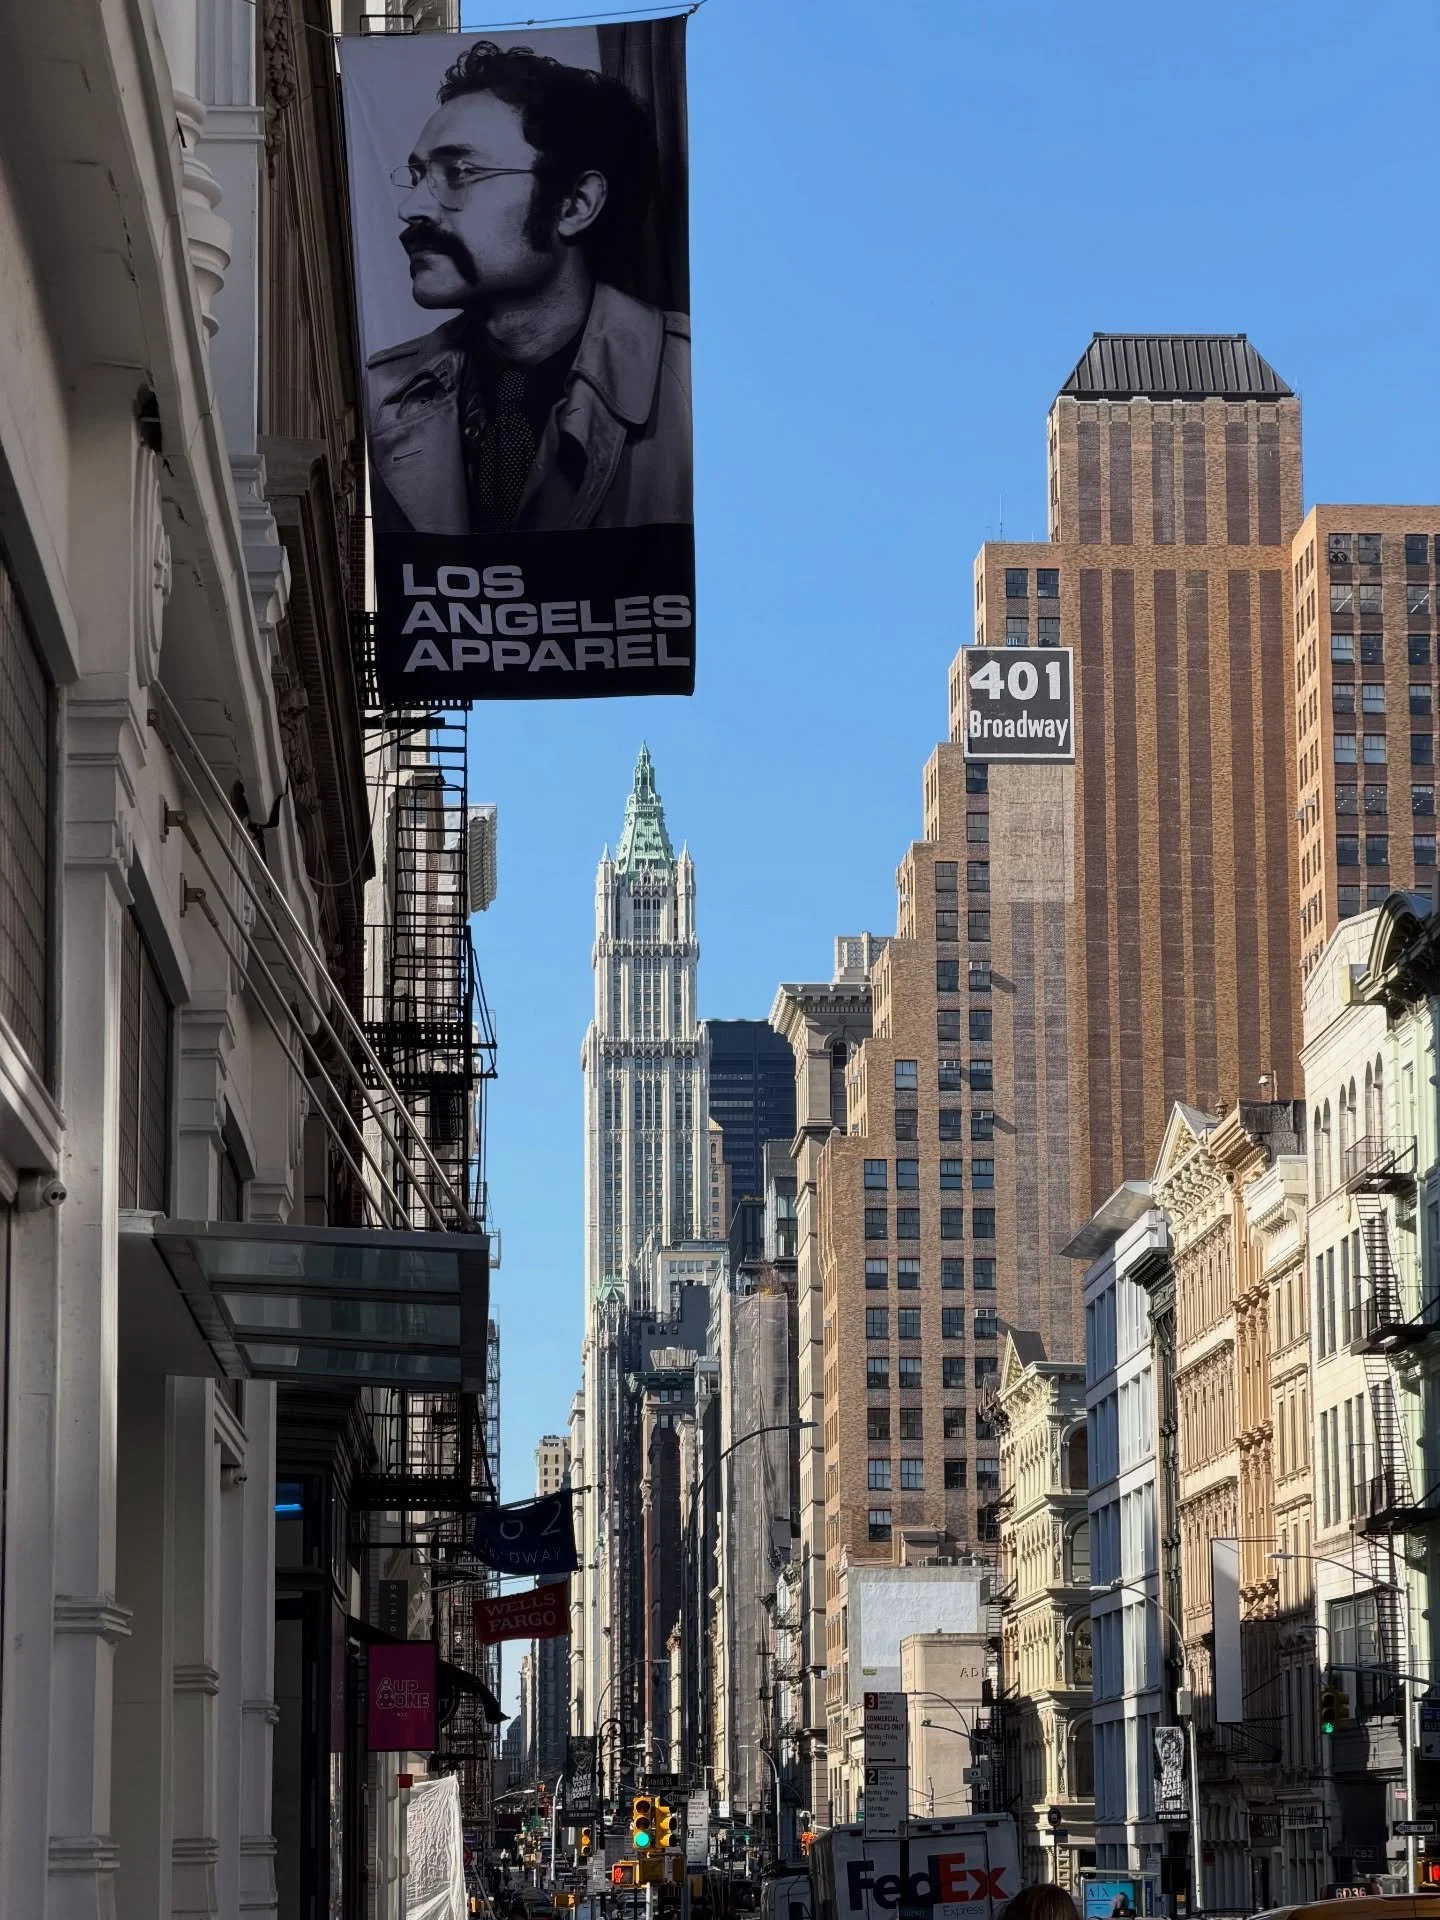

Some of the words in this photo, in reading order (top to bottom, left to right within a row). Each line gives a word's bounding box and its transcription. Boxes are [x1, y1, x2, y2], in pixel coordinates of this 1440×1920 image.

[402, 563, 525, 599] LOS
[400, 594, 692, 636] ANGELES
[402, 633, 690, 673] APPAREL
[969, 660, 1061, 701] 401
[969, 710, 1069, 747] Broadway
[484, 1592, 557, 1617] WELLS
[487, 1610, 557, 1633] FARGO
[394, 1679, 419, 1692] UP
[395, 1692, 430, 1709] ONE
[868, 1694, 875, 1709] 3
[866, 1723, 890, 1731] VEHICLES
[891, 1723, 905, 1731] ONLY
[572, 1773, 592, 1782] MAKE
[868, 1769, 876, 1784] 2
[1353, 1849, 1375, 1858] CB2
[847, 1853, 1007, 1910] FedEx
[1335, 1887, 1366, 1899] 6D36
[943, 1903, 985, 1918] Express
